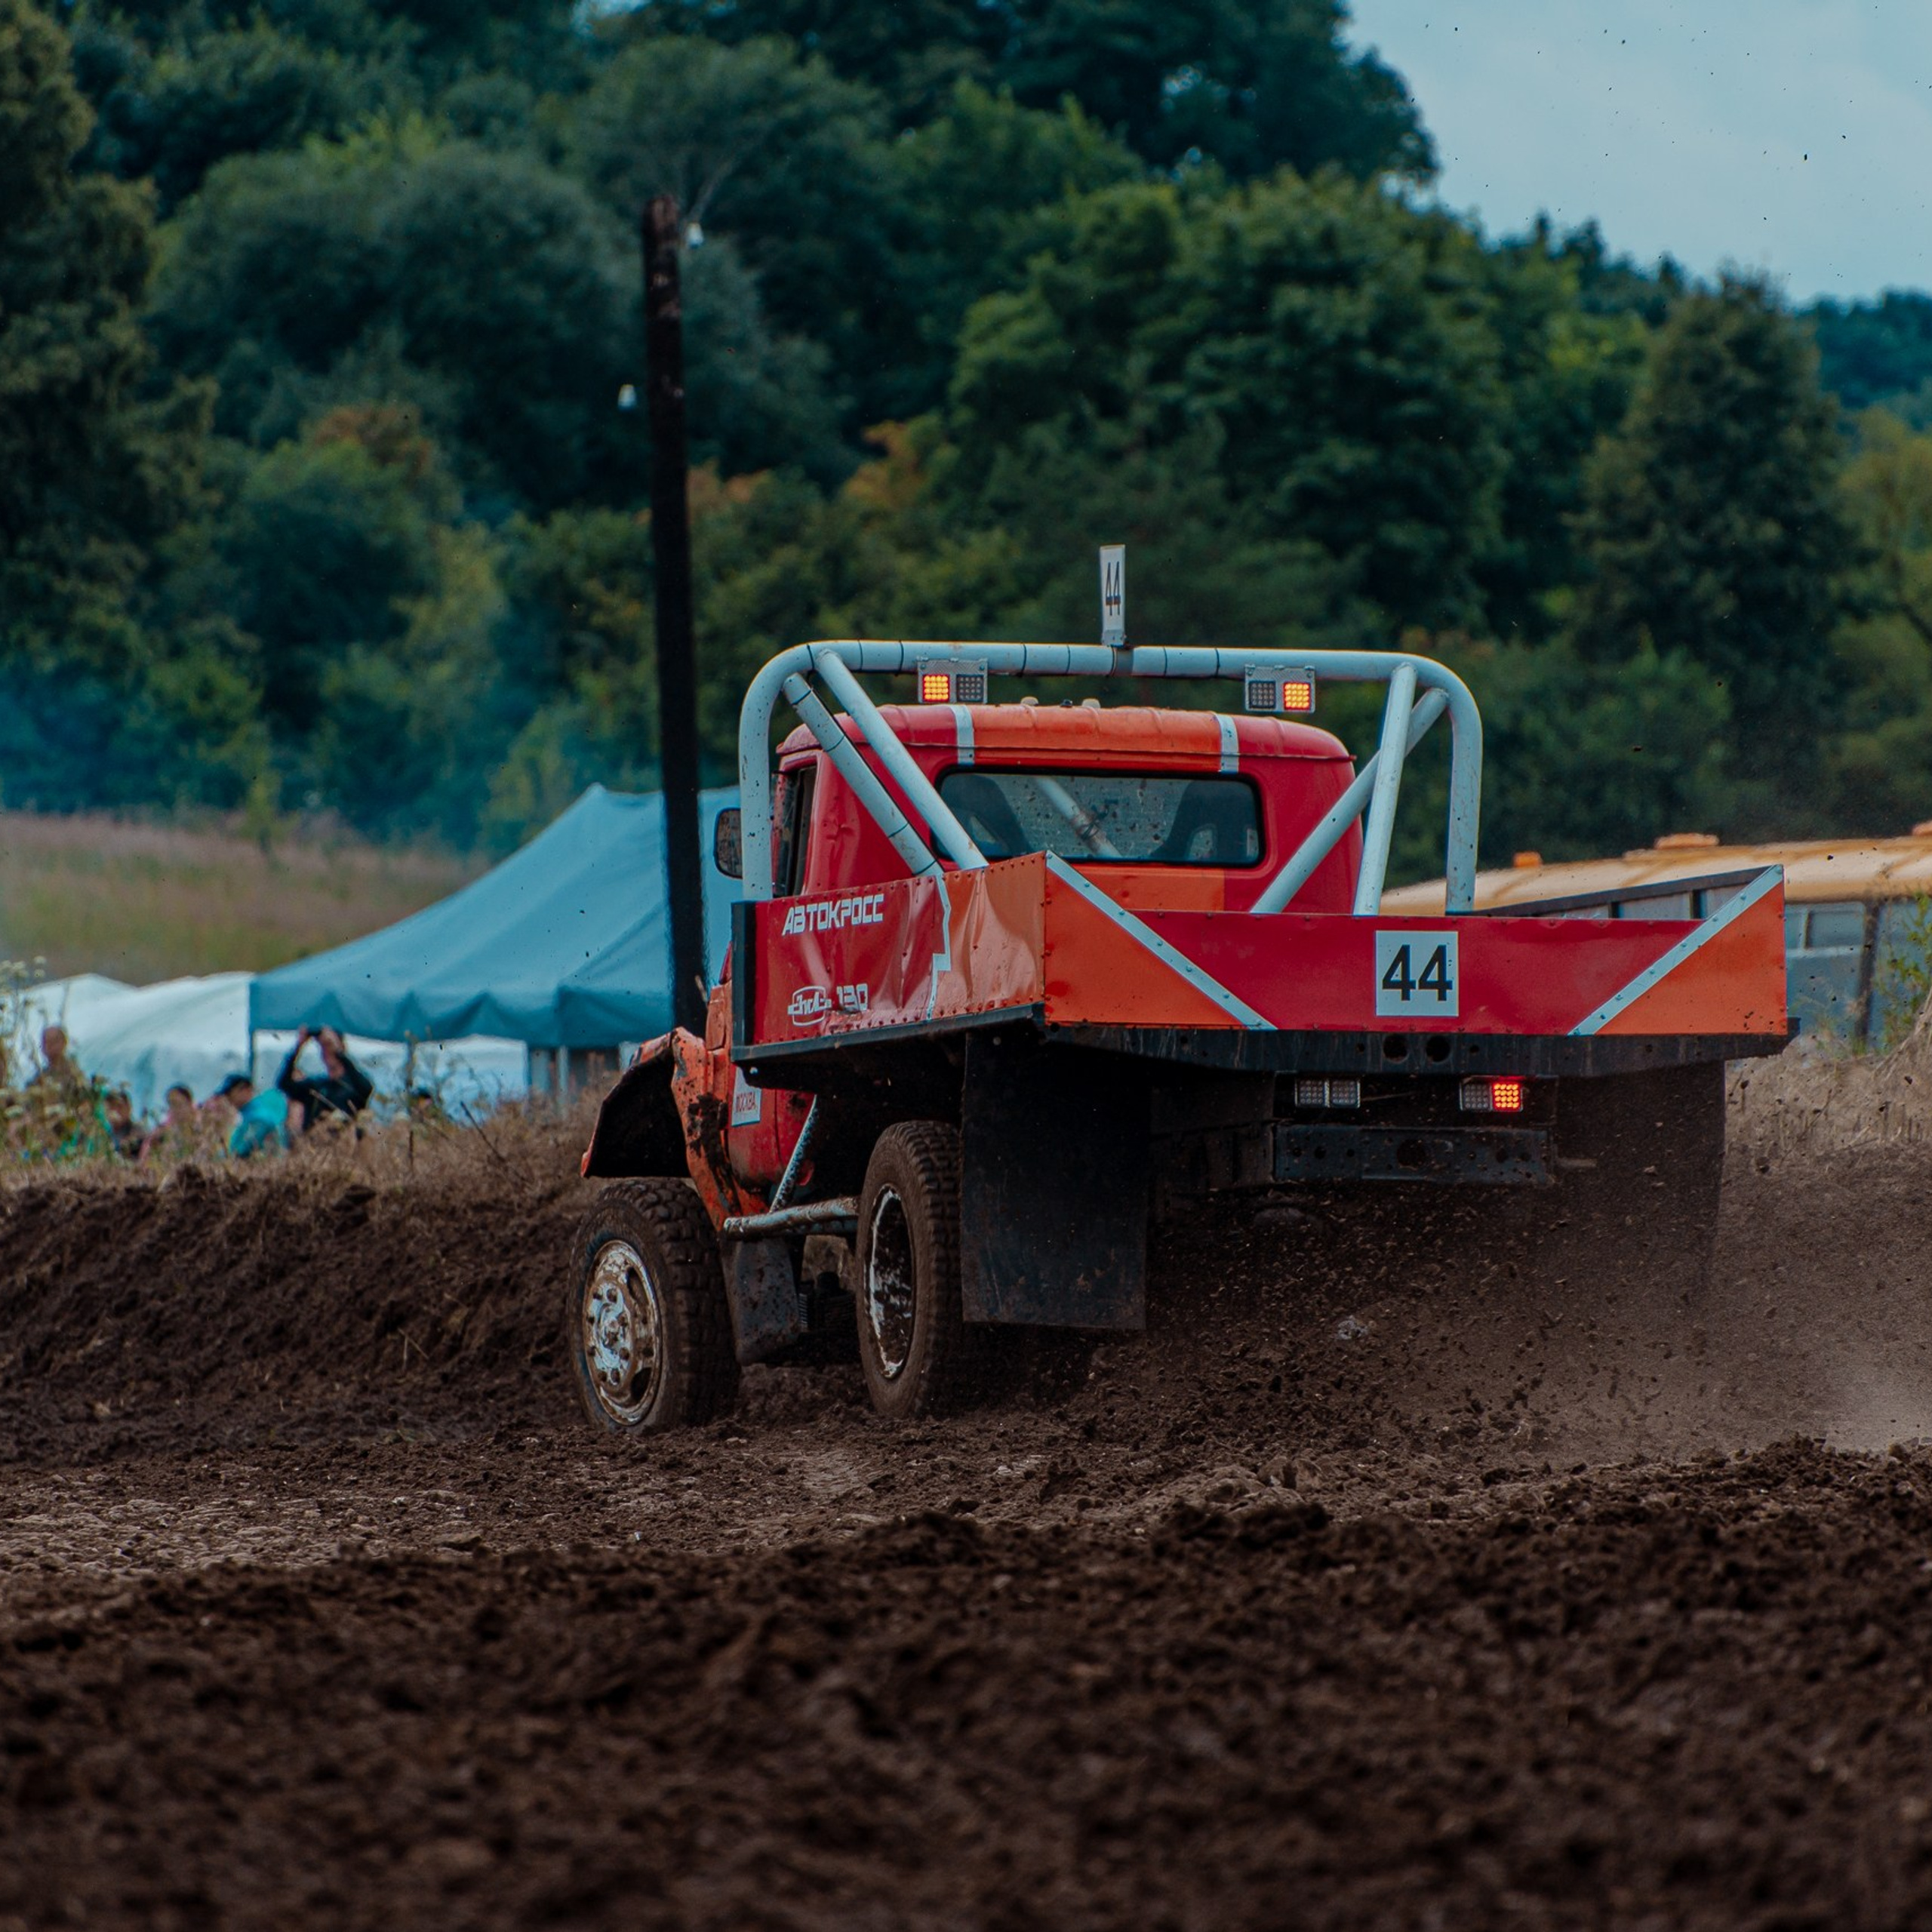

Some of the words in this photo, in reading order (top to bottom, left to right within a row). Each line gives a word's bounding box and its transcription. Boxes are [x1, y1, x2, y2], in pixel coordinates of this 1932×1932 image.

[1106, 561, 1121, 616] 44
[782, 894, 884, 936] АВТОКРОСС
[1382, 944, 1454, 1001] 44
[836, 983, 868, 1012] 130
